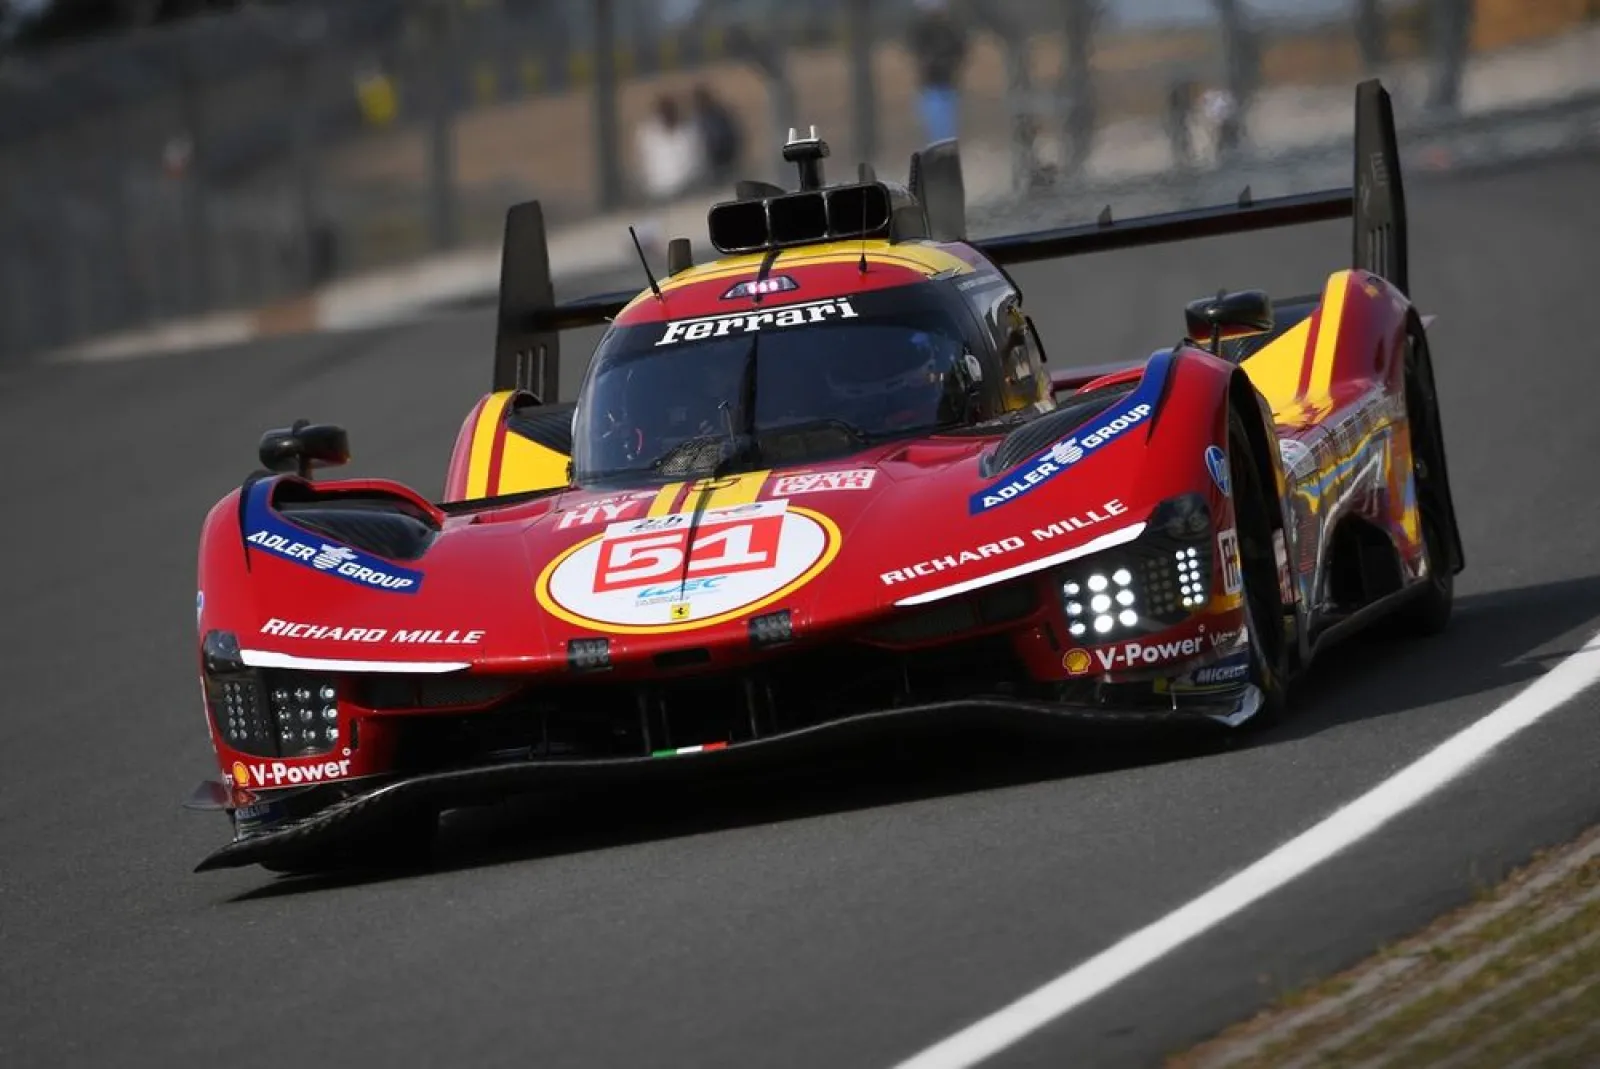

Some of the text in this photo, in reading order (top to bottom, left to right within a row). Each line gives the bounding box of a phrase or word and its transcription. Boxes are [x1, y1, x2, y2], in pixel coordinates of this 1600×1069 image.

[654, 297, 859, 347] Ferrari
[982, 403, 1152, 508] ADLER GROUP
[247, 530, 414, 590] ADLER GROUP
[604, 523, 768, 584] 51
[879, 498, 1129, 586] RICHARD MILLE
[260, 617, 486, 645] RICHARD MILLE
[1095, 636, 1204, 670] V-Power
[249, 759, 351, 786] V-Power
